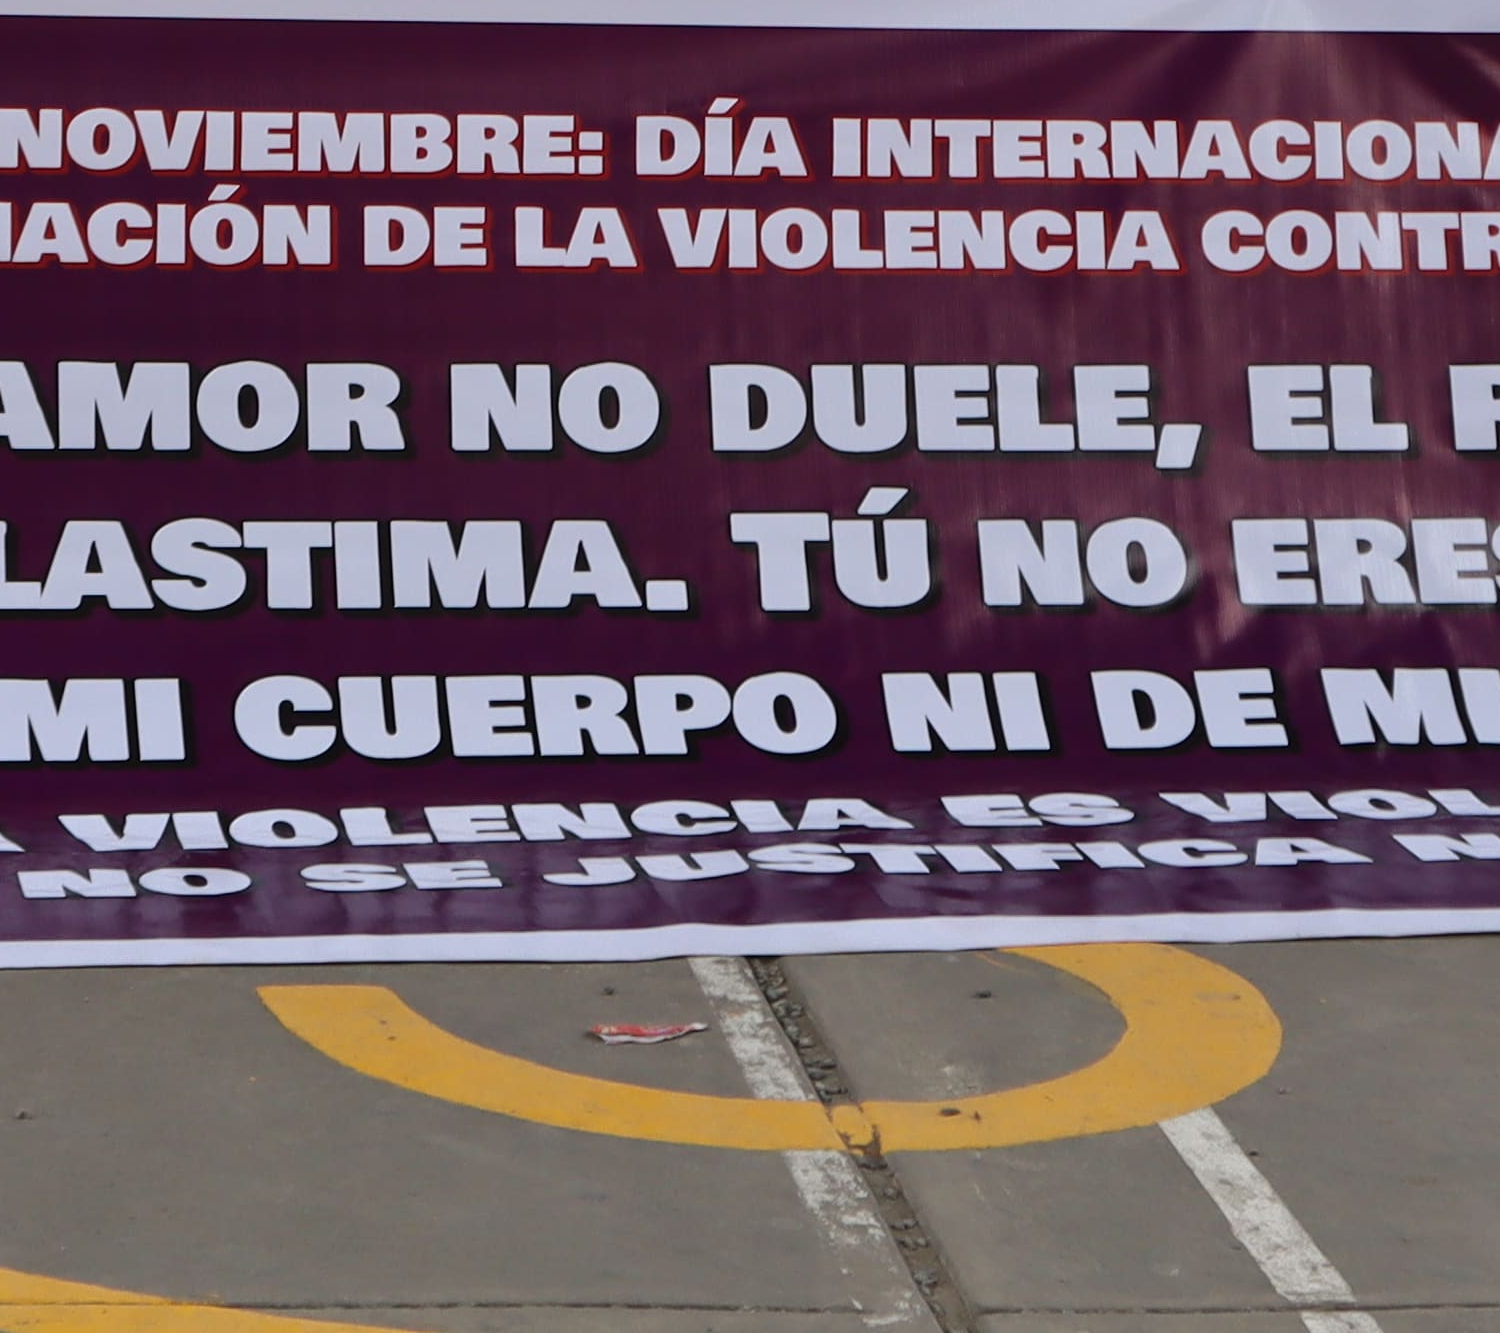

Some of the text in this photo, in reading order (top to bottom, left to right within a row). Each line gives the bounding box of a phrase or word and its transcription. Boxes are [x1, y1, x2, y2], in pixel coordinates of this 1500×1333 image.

[634, 97, 807, 179] DÍA
[362, 205, 488, 268] DE
[514, 206, 638, 269] LA
[658, 207, 1176, 273] VIOLENCIA
[449, 362, 661, 452] NO
[709, 362, 1202, 470] DUELE,
[1247, 364, 1410, 452] EL
[729, 487, 931, 612] TÚ
[977, 516, 1189, 608] NO
[233, 671, 838, 760] CUERPO
[882, 671, 1048, 754] NI
[1091, 667, 1290, 751] DE
[57, 797, 911, 852] VIOLENCIA
[941, 792, 1134, 828] ES
[17, 866, 251, 900] NO
[301, 859, 502, 894] SE
[541, 835, 1372, 886] JUSTIFICA
